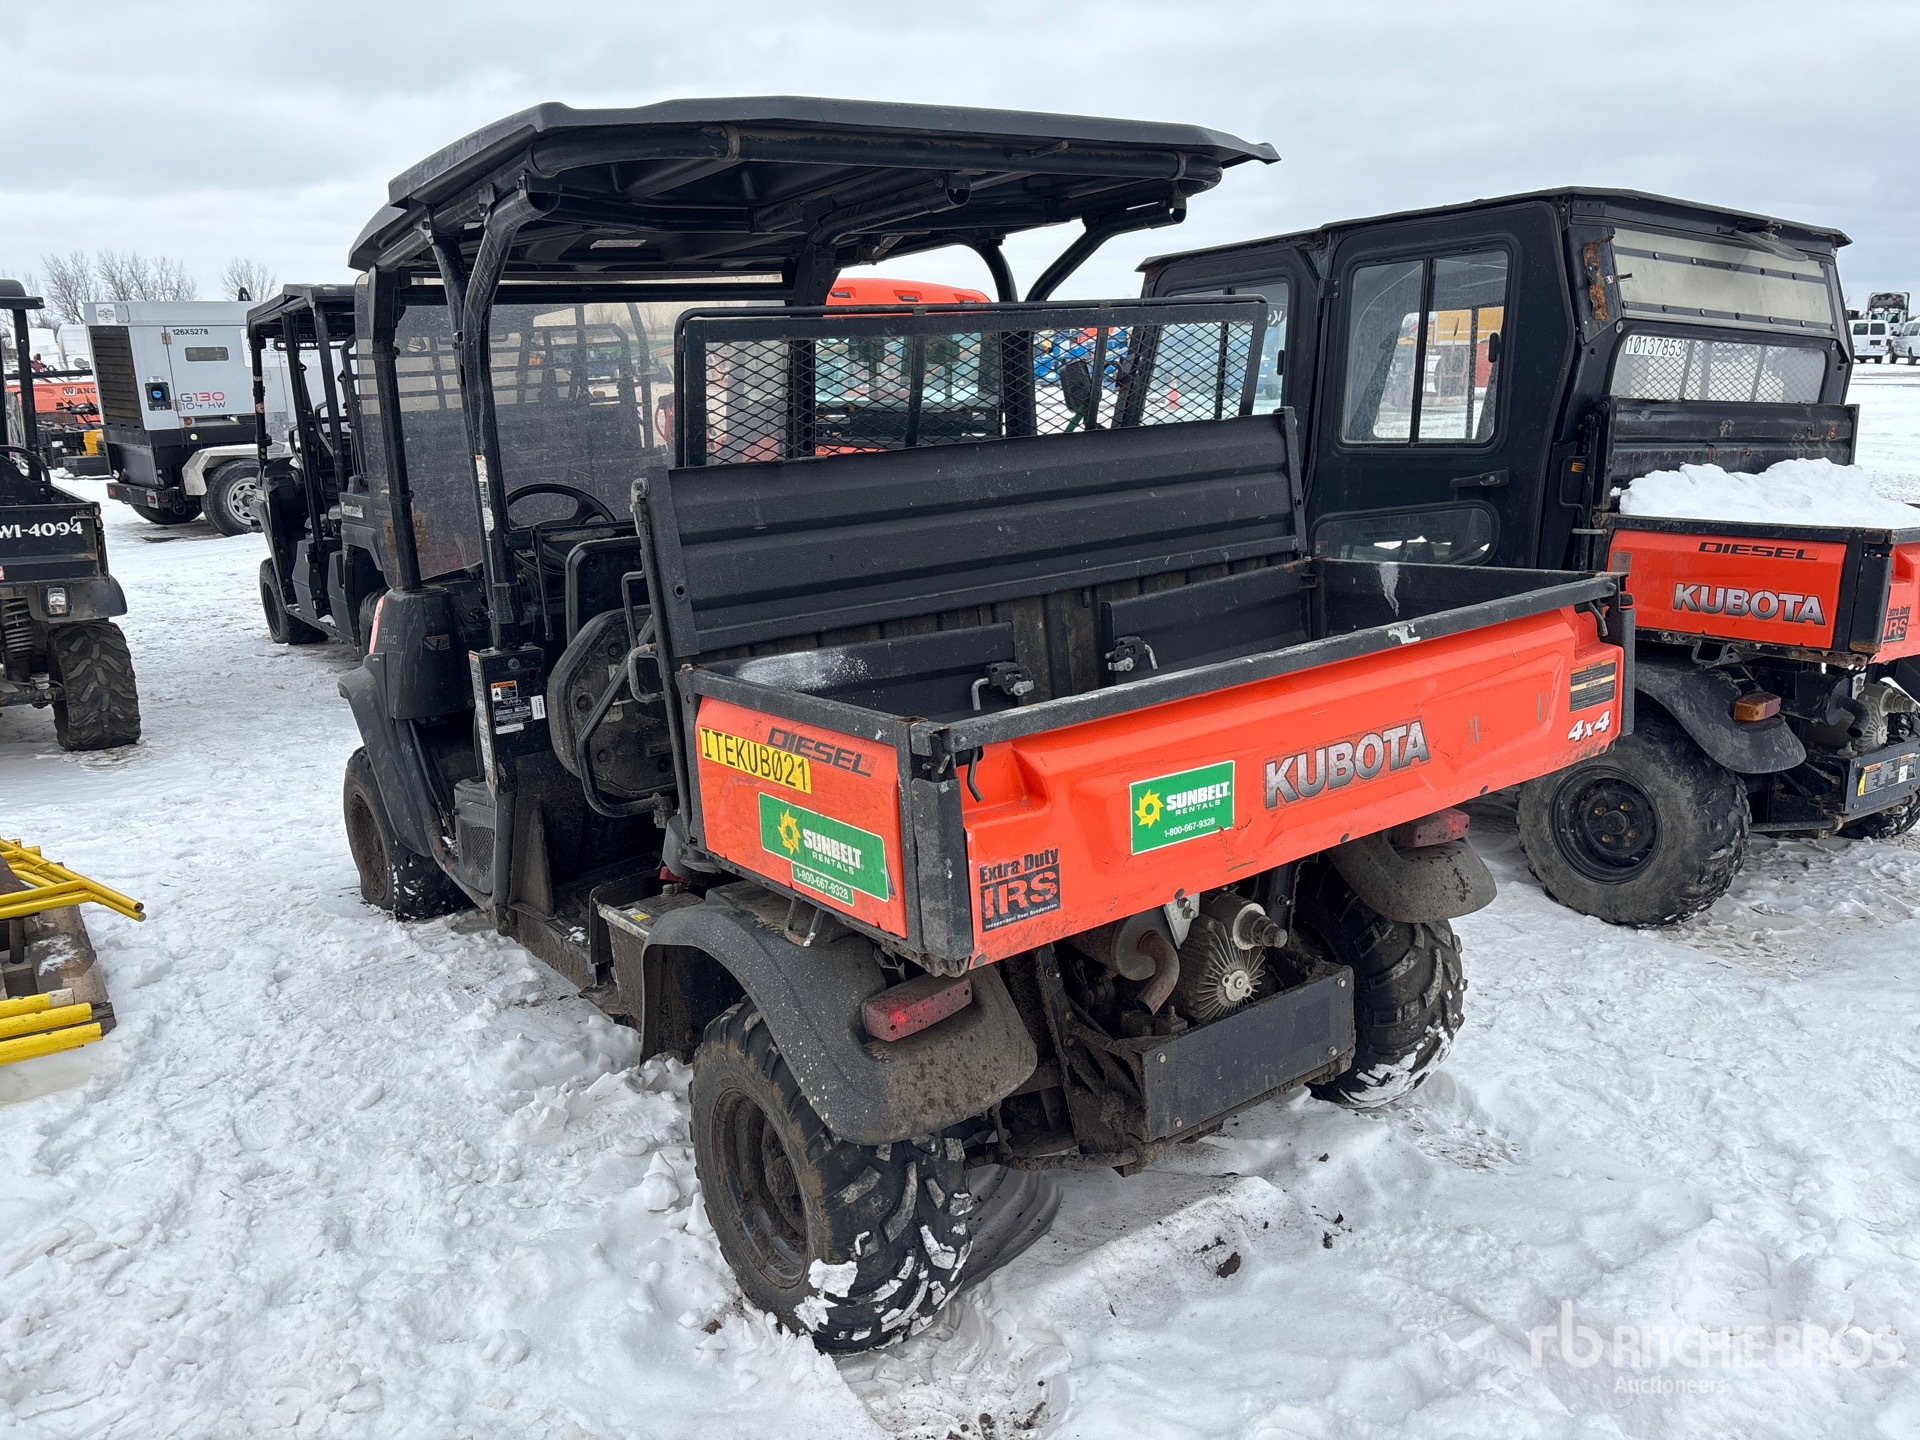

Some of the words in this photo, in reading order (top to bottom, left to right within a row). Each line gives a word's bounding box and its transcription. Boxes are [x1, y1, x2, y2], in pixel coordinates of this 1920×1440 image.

[172, 328, 209, 336] 126X5278
[1628, 336, 1684, 357] 10137853
[180, 391, 225, 403] G130
[181, 402, 203, 410] 104
[0, 521, 84, 539] WI-4094
[1698, 541, 1818, 561] DIESEL
[1672, 582, 1826, 626] KUBOTA
[1567, 710, 1611, 742] 4x4
[767, 727, 872, 778] DIESEL
[1265, 720, 1431, 810] KUBOTA
[1166, 781, 1231, 812] SUNBELT
[1175, 799, 1221, 816] RENTALS
[1163, 817, 1216, 838] 1-800-667-9328
[802, 828, 863, 870] SUNBELT
[812, 851, 855, 875] RENTALS
[979, 860, 1020, 884] Extra
[1023, 848, 1059, 872] Duty
[795, 867, 849, 900] 1-800-667-9328
[984, 871, 1058, 919] IRS
